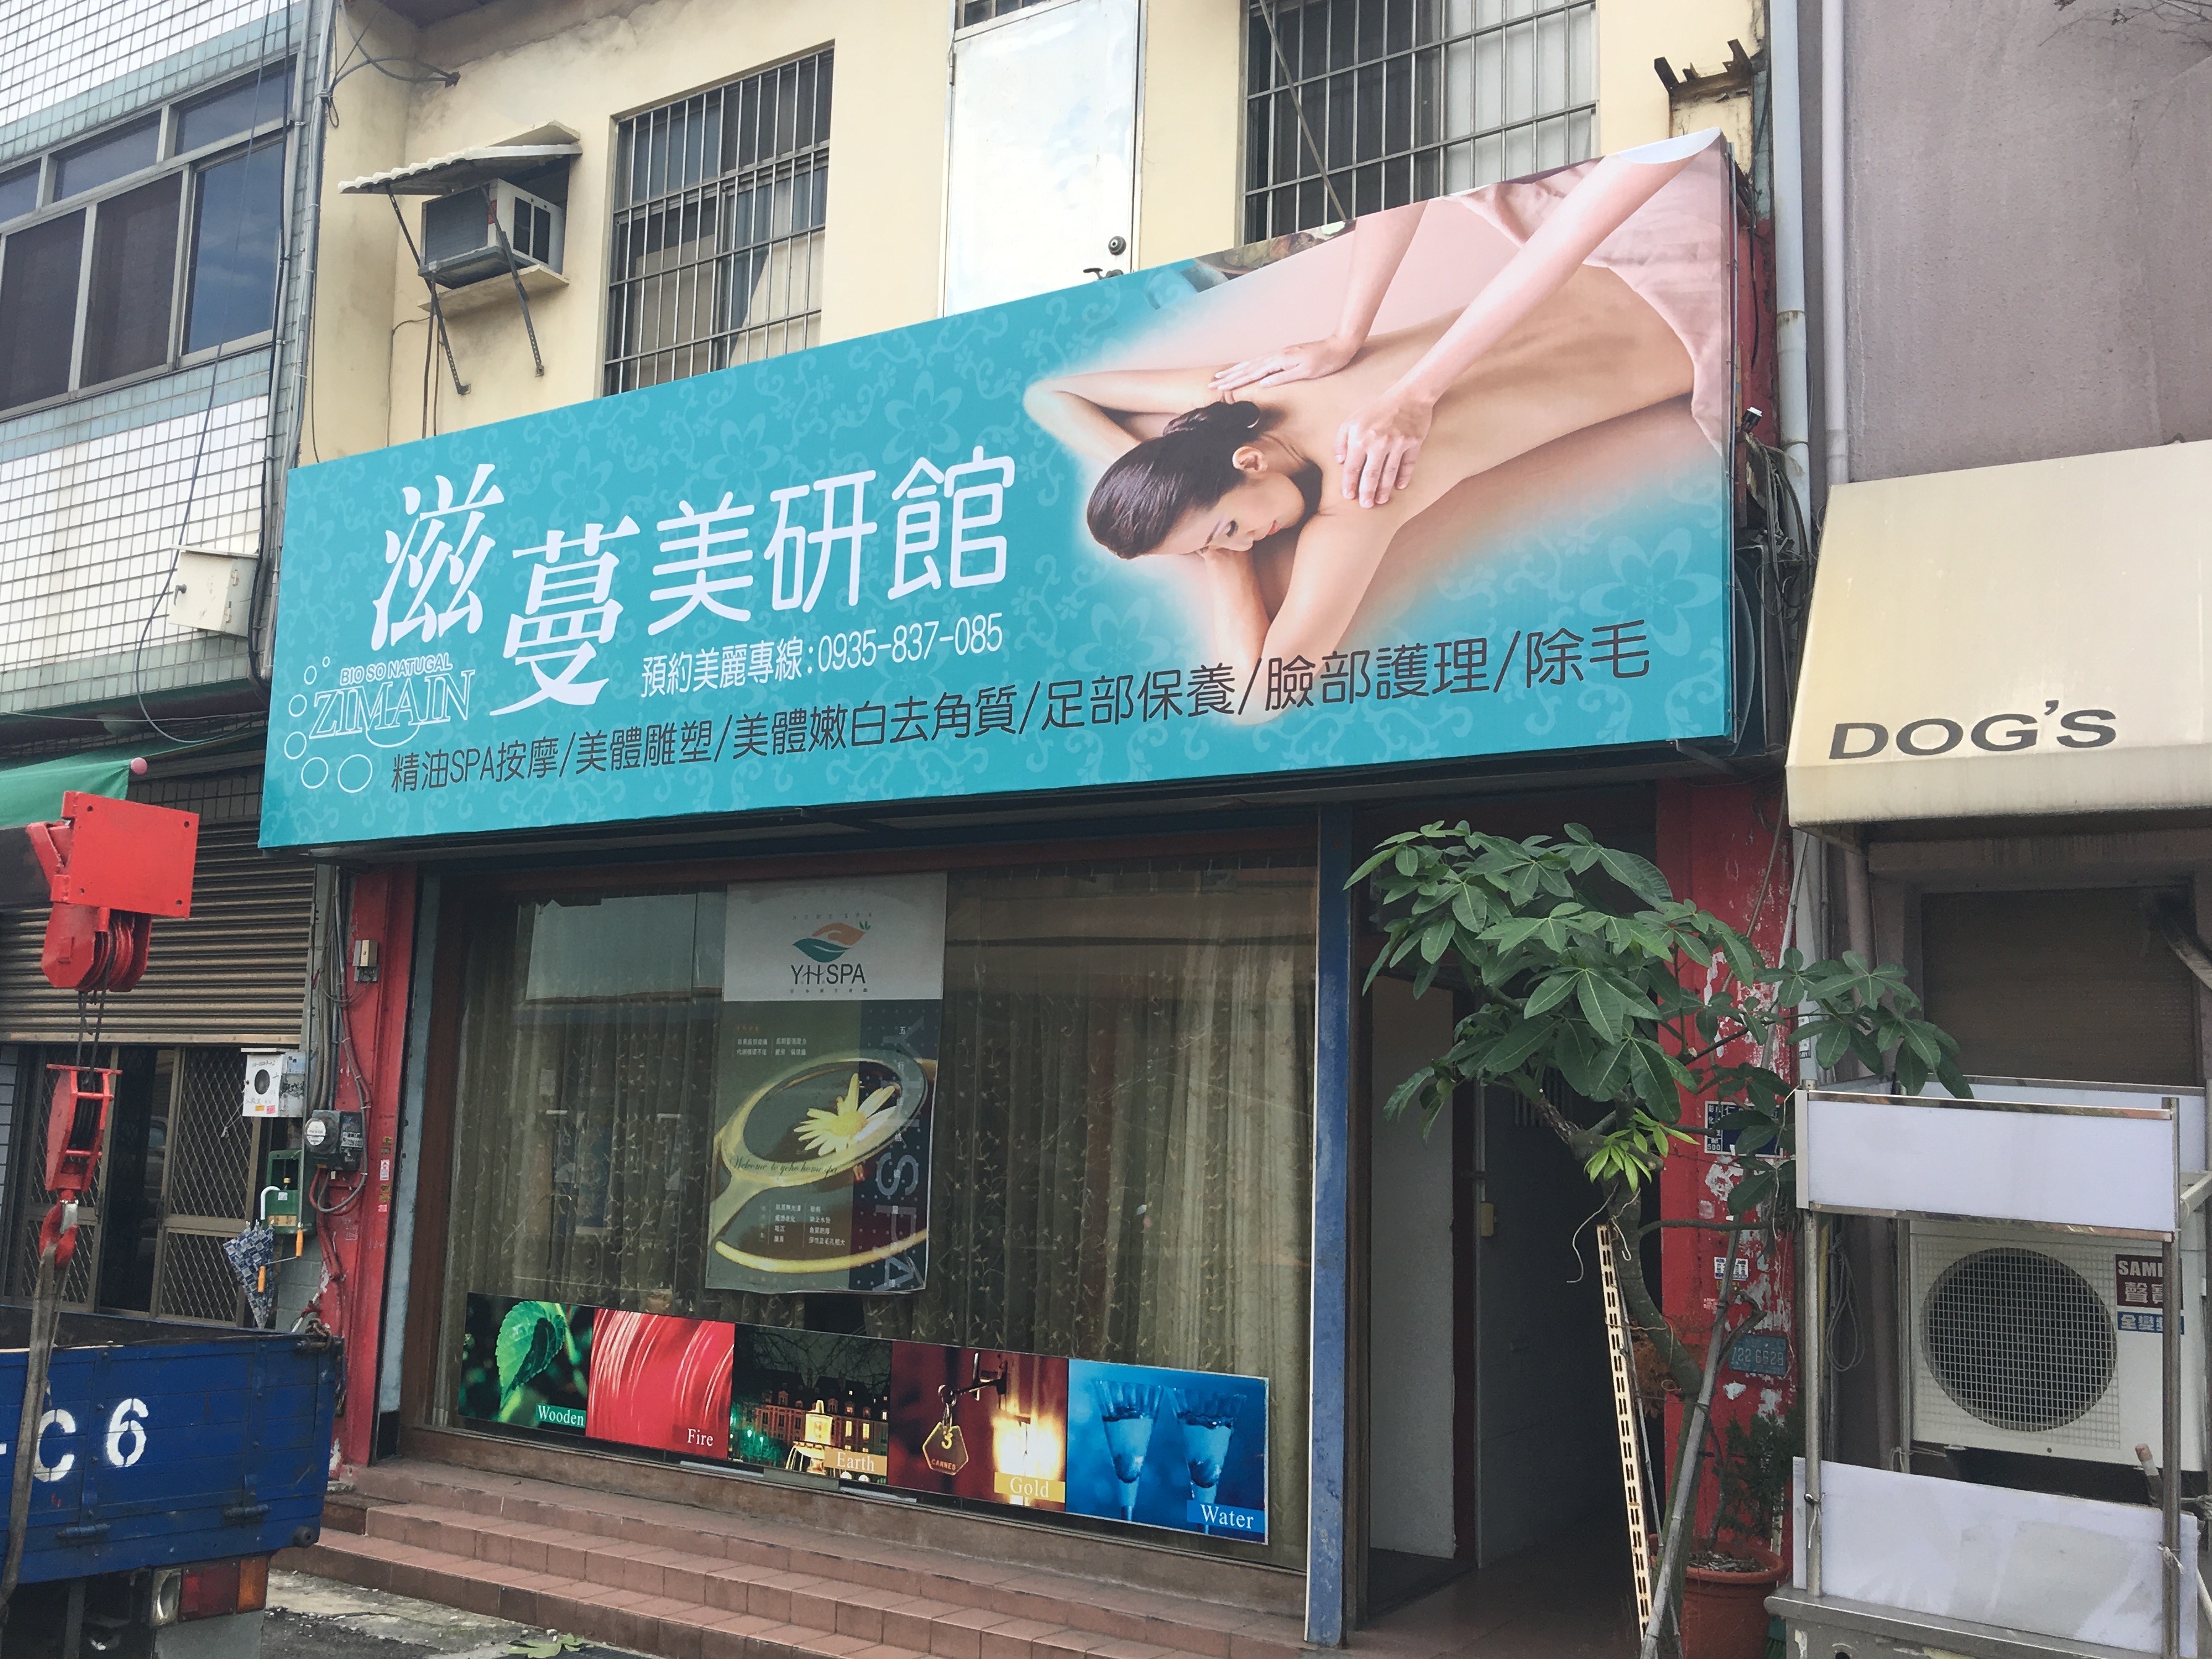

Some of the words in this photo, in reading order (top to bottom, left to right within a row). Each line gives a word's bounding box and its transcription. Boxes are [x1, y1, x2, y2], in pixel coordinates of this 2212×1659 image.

[340, 666, 365, 686] BIO
[366, 662, 386, 681] SO
[309, 670, 475, 740] ZIMAIN
[1829, 699, 2116, 759] DOG'S
[2118, 1260, 2163, 1277] SAM
[537, 1404, 585, 1427] Wooden
[686, 1428, 714, 1447] Fire
[836, 1452, 876, 1473] Earth
[931, 1459, 956, 1471] CANNES
[1009, 1477, 1050, 1498] Gold
[1200, 1504, 1254, 1529] Water
